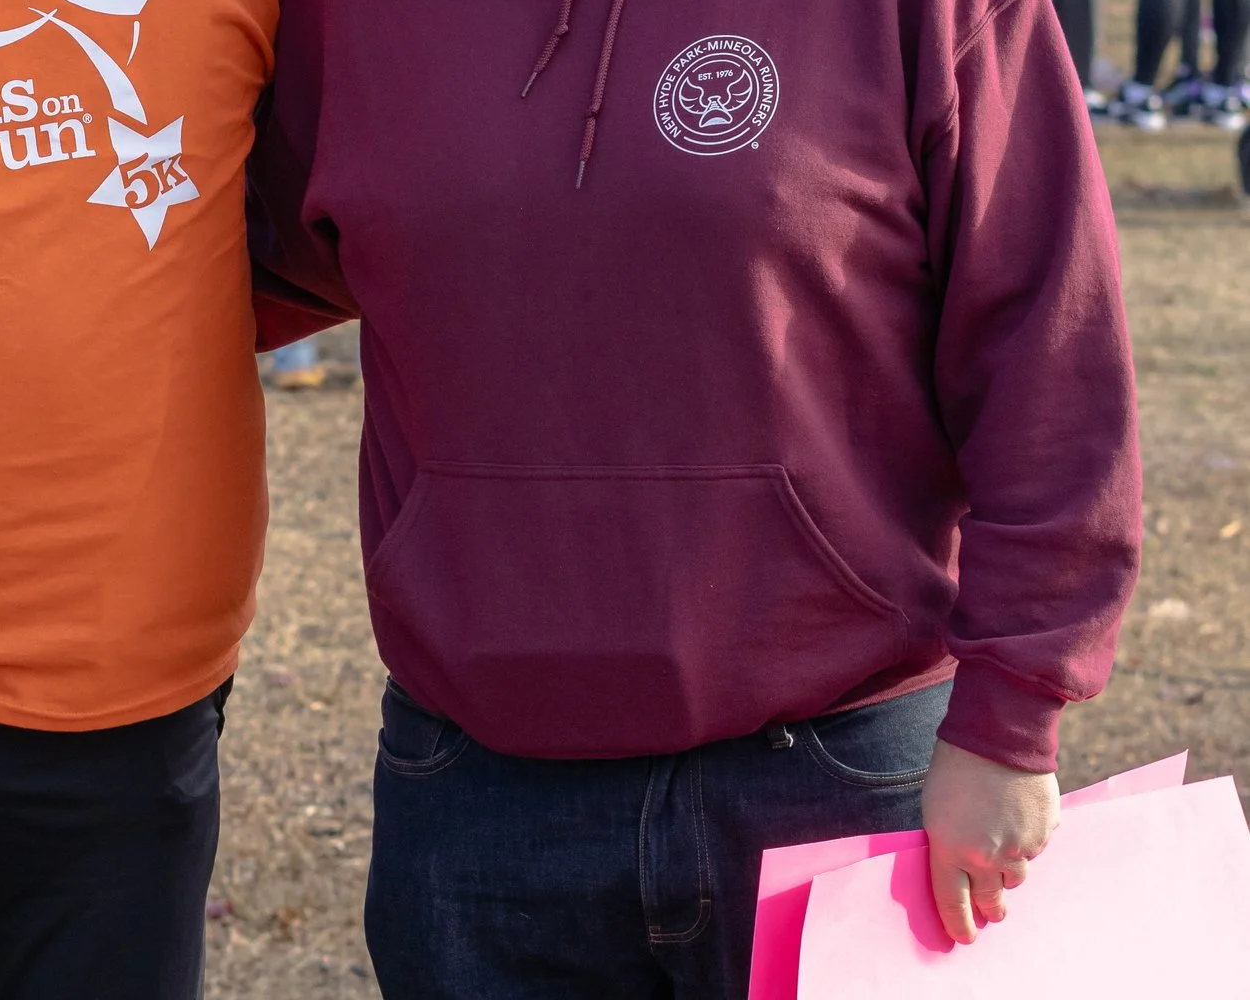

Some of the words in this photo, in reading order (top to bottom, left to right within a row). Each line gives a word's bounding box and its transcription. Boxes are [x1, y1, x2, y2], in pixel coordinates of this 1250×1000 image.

[672, 40, 763, 72] PARK-MINEOLA
[658, 73, 676, 108] HYDE
[698, 72, 714, 81] EST.
[716, 69, 733, 79] 1976
[42, 94, 83, 116] on
[752, 66, 774, 126] RUNNERS
[659, 112, 682, 138] NEW
[118, 152, 188, 209] 5K
